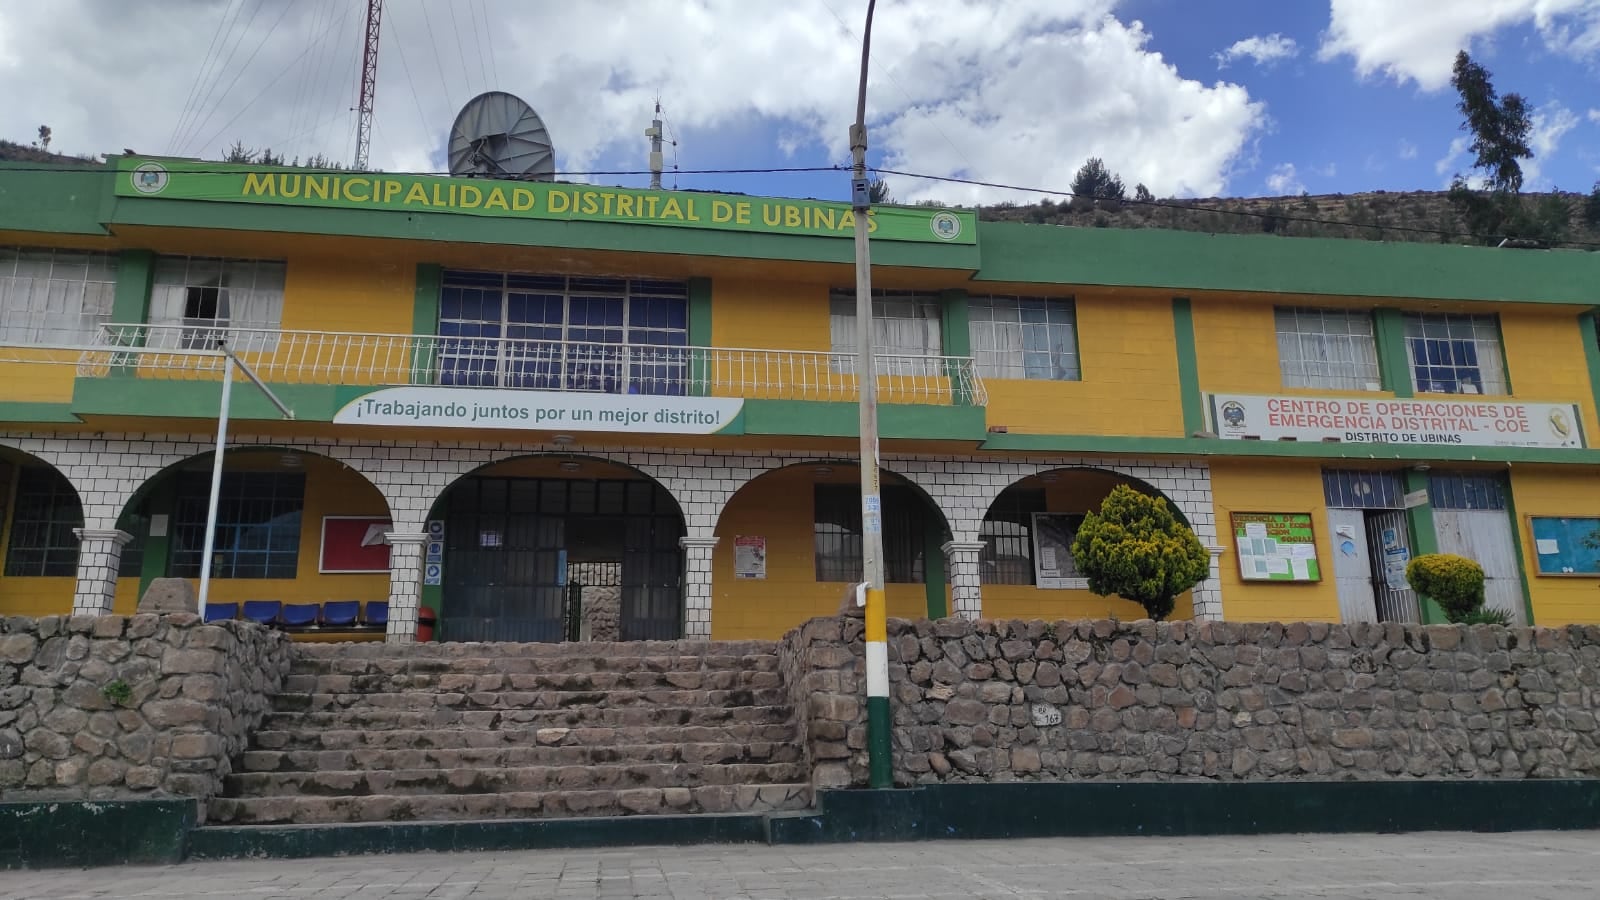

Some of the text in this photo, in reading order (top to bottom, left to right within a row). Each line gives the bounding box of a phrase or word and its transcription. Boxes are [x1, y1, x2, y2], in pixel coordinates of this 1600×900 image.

[241, 172, 536, 212] MUNICIPALIDAD
[547, 190, 700, 221] DISTRITAL
[712, 201, 751, 225] DE
[356, 398, 721, 426] ¡Trabajando juntos por un mejor distrito!
[1267, 399, 1527, 419] CENTRO DE OPERACIONES DE
[1268, 413, 1387, 430] EMERGENCIA
[1391, 417, 1480, 432] DISTRITAL
[1494, 419, 1531, 433] COE
[1344, 431, 1463, 444] DISTRITO DE UBINAS
